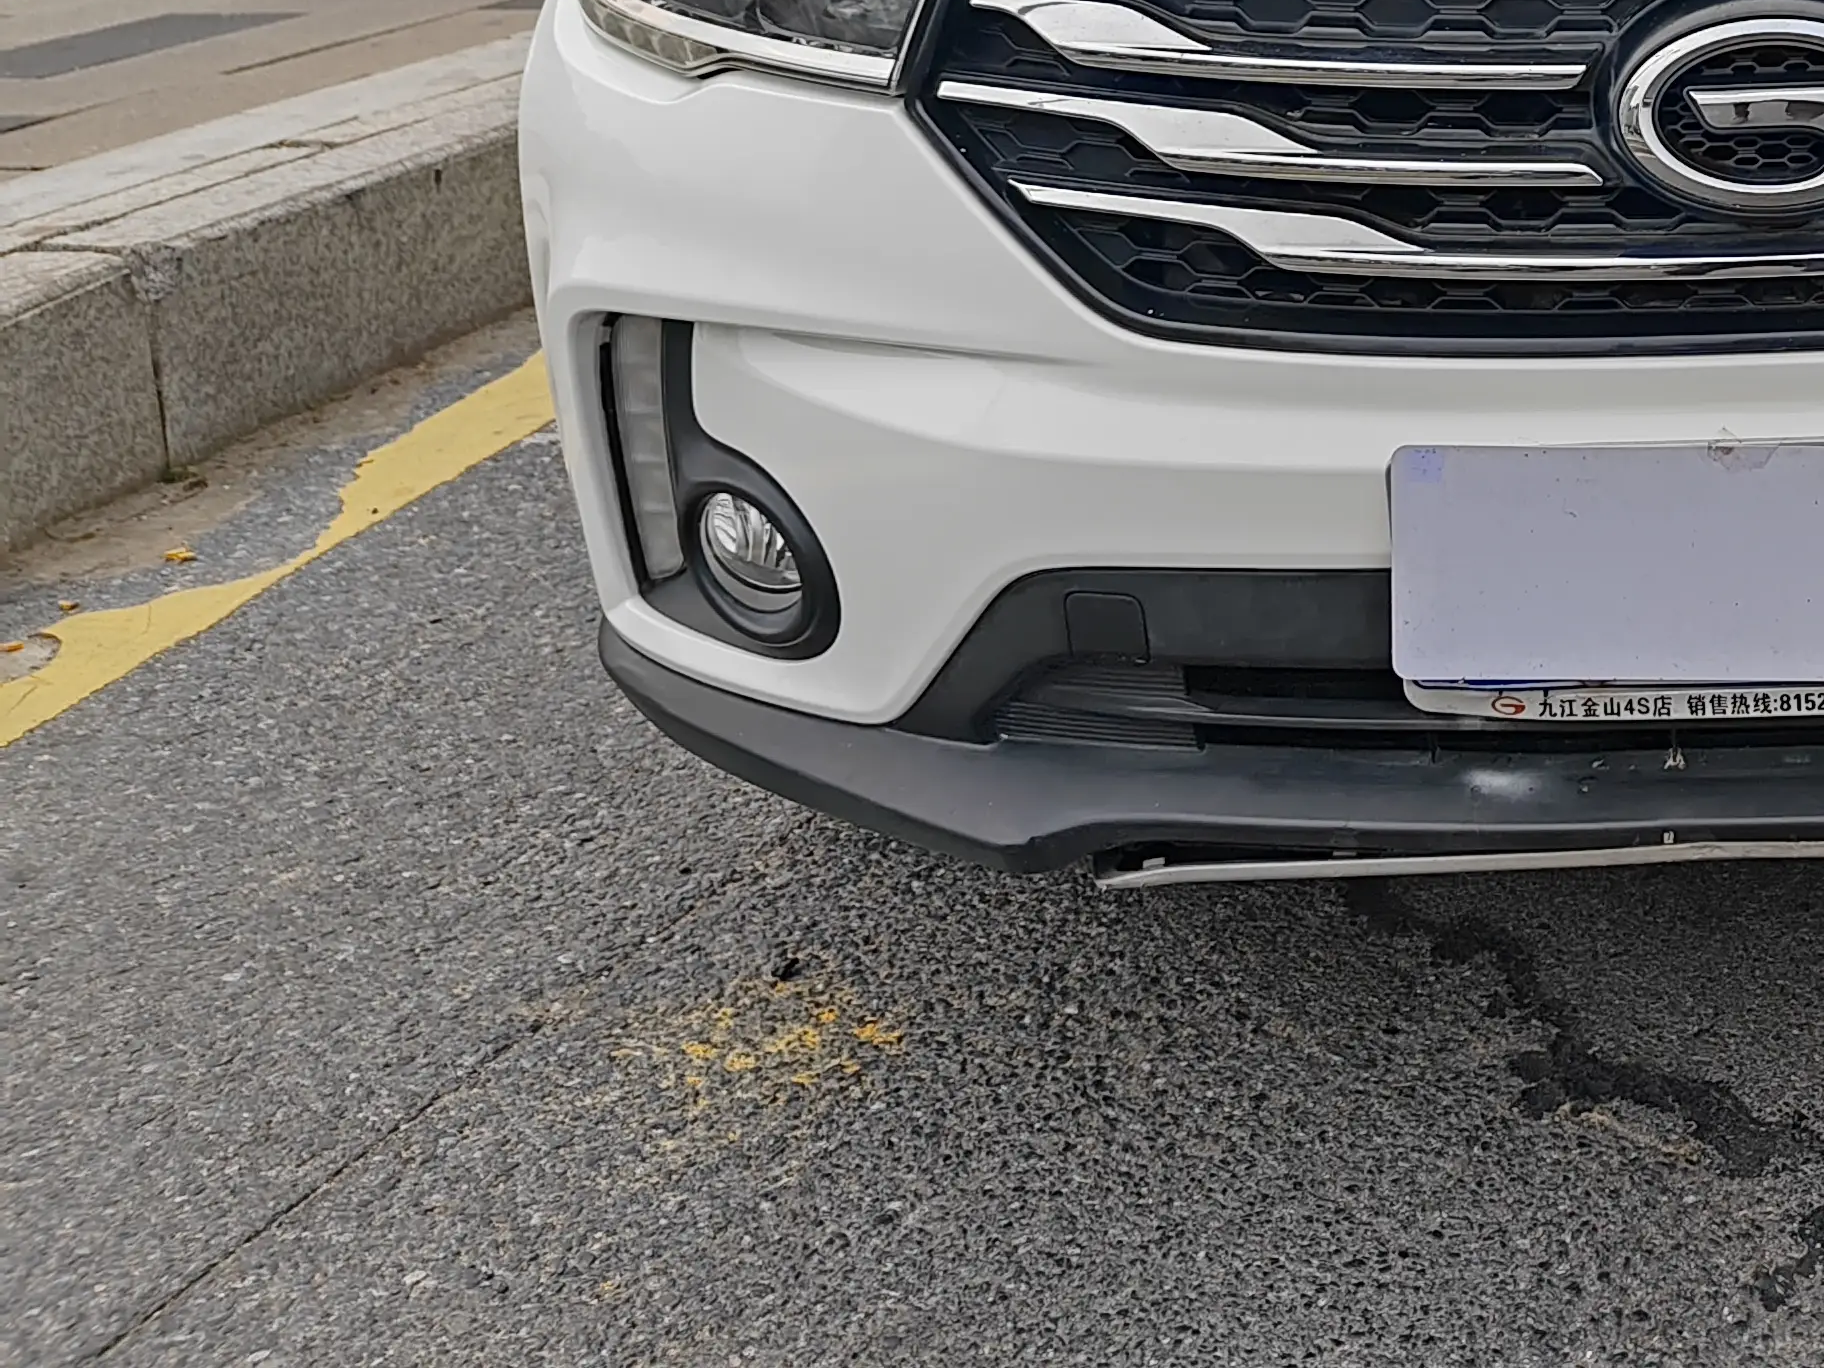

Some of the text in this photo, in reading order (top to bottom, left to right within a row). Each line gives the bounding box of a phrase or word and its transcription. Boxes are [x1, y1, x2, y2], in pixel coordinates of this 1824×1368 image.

[1538, 695, 1673, 718] 九江金山4S店
